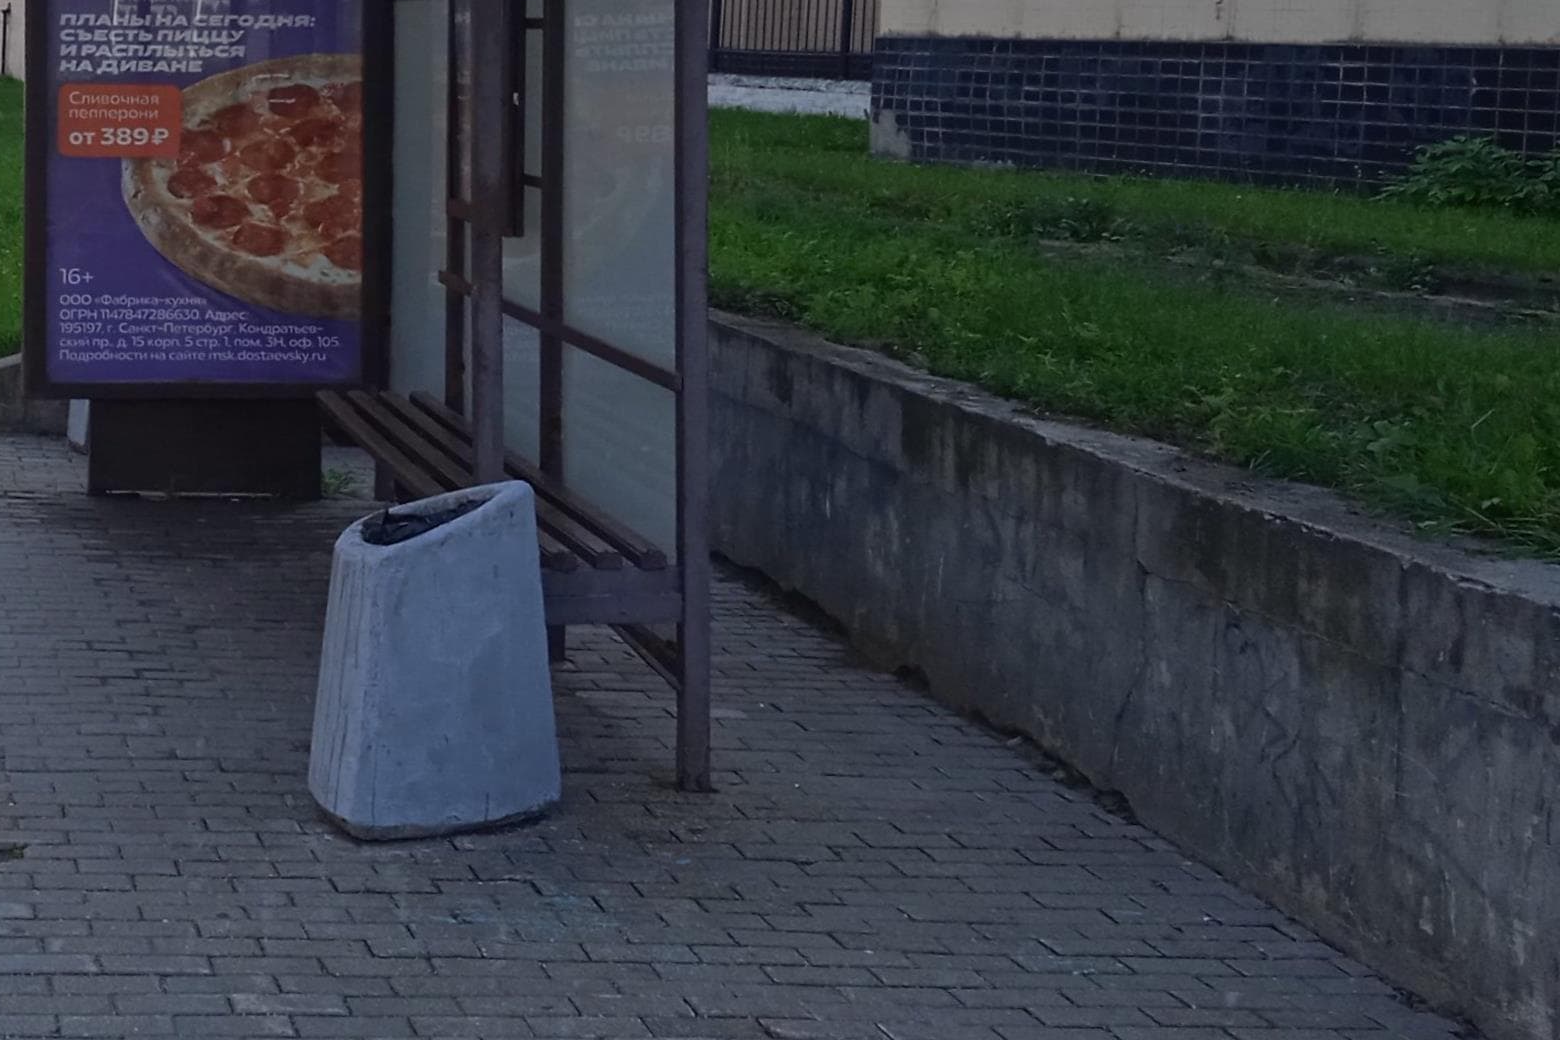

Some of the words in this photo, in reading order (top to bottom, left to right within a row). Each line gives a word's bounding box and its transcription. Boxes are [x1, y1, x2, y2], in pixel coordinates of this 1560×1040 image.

[58, 13, 151, 27] ПЛАНЫ
[155, 14, 189, 27] НА
[192, 14, 317, 30] СЕГОДНЯ:
[59, 29, 154, 43] СЪЕСТЬ
[156, 29, 245, 45] ПИЦЦУ
[59, 44, 77, 57] И
[80, 44, 246, 58] РАСПЛЫТЬСЯ
[58, 59, 94, 72] НА
[96, 59, 204, 75] ДИВАНЕ
[68, 91, 160, 107] Сливочная
[68, 107, 160, 122] пепперони
[68, 131, 95, 145] от
[59, 267, 94, 285] 16+
[59, 294, 92, 306] ООО
[59, 309, 98, 320] ОГРН
[131, 335, 145, 347] 15
[59, 349, 149, 362] Подробности
[150, 351, 166, 361] на
